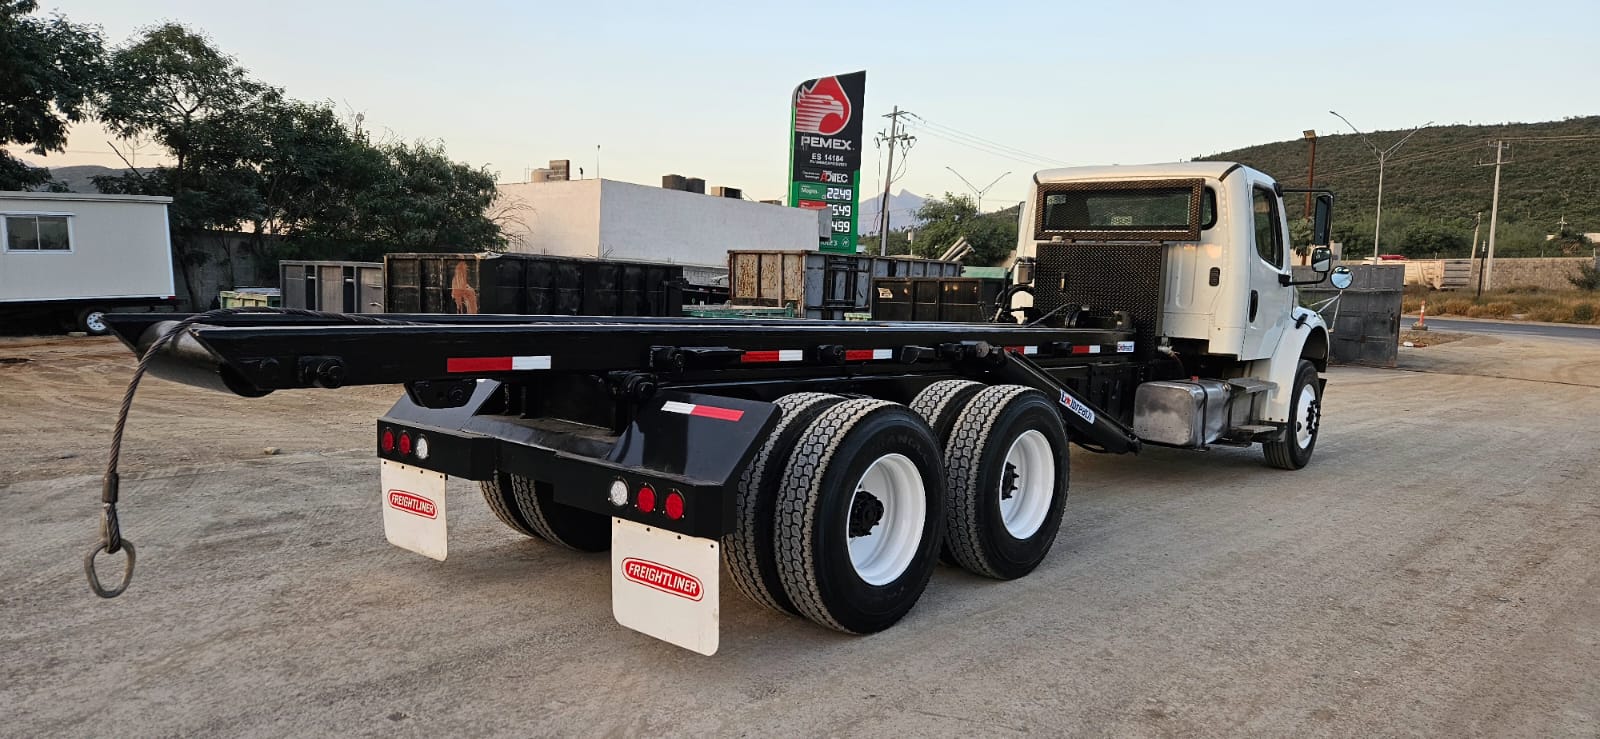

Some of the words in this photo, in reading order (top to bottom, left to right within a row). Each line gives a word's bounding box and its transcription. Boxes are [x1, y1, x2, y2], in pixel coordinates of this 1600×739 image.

[801, 136, 852, 151] PEMEX
[811, 152, 822, 160] ES
[827, 204, 851, 217] 5.49
[831, 221, 850, 233] 4.99
[391, 494, 434, 514] FREIGHTLINER
[628, 563, 697, 594] FREIGHTLINER
